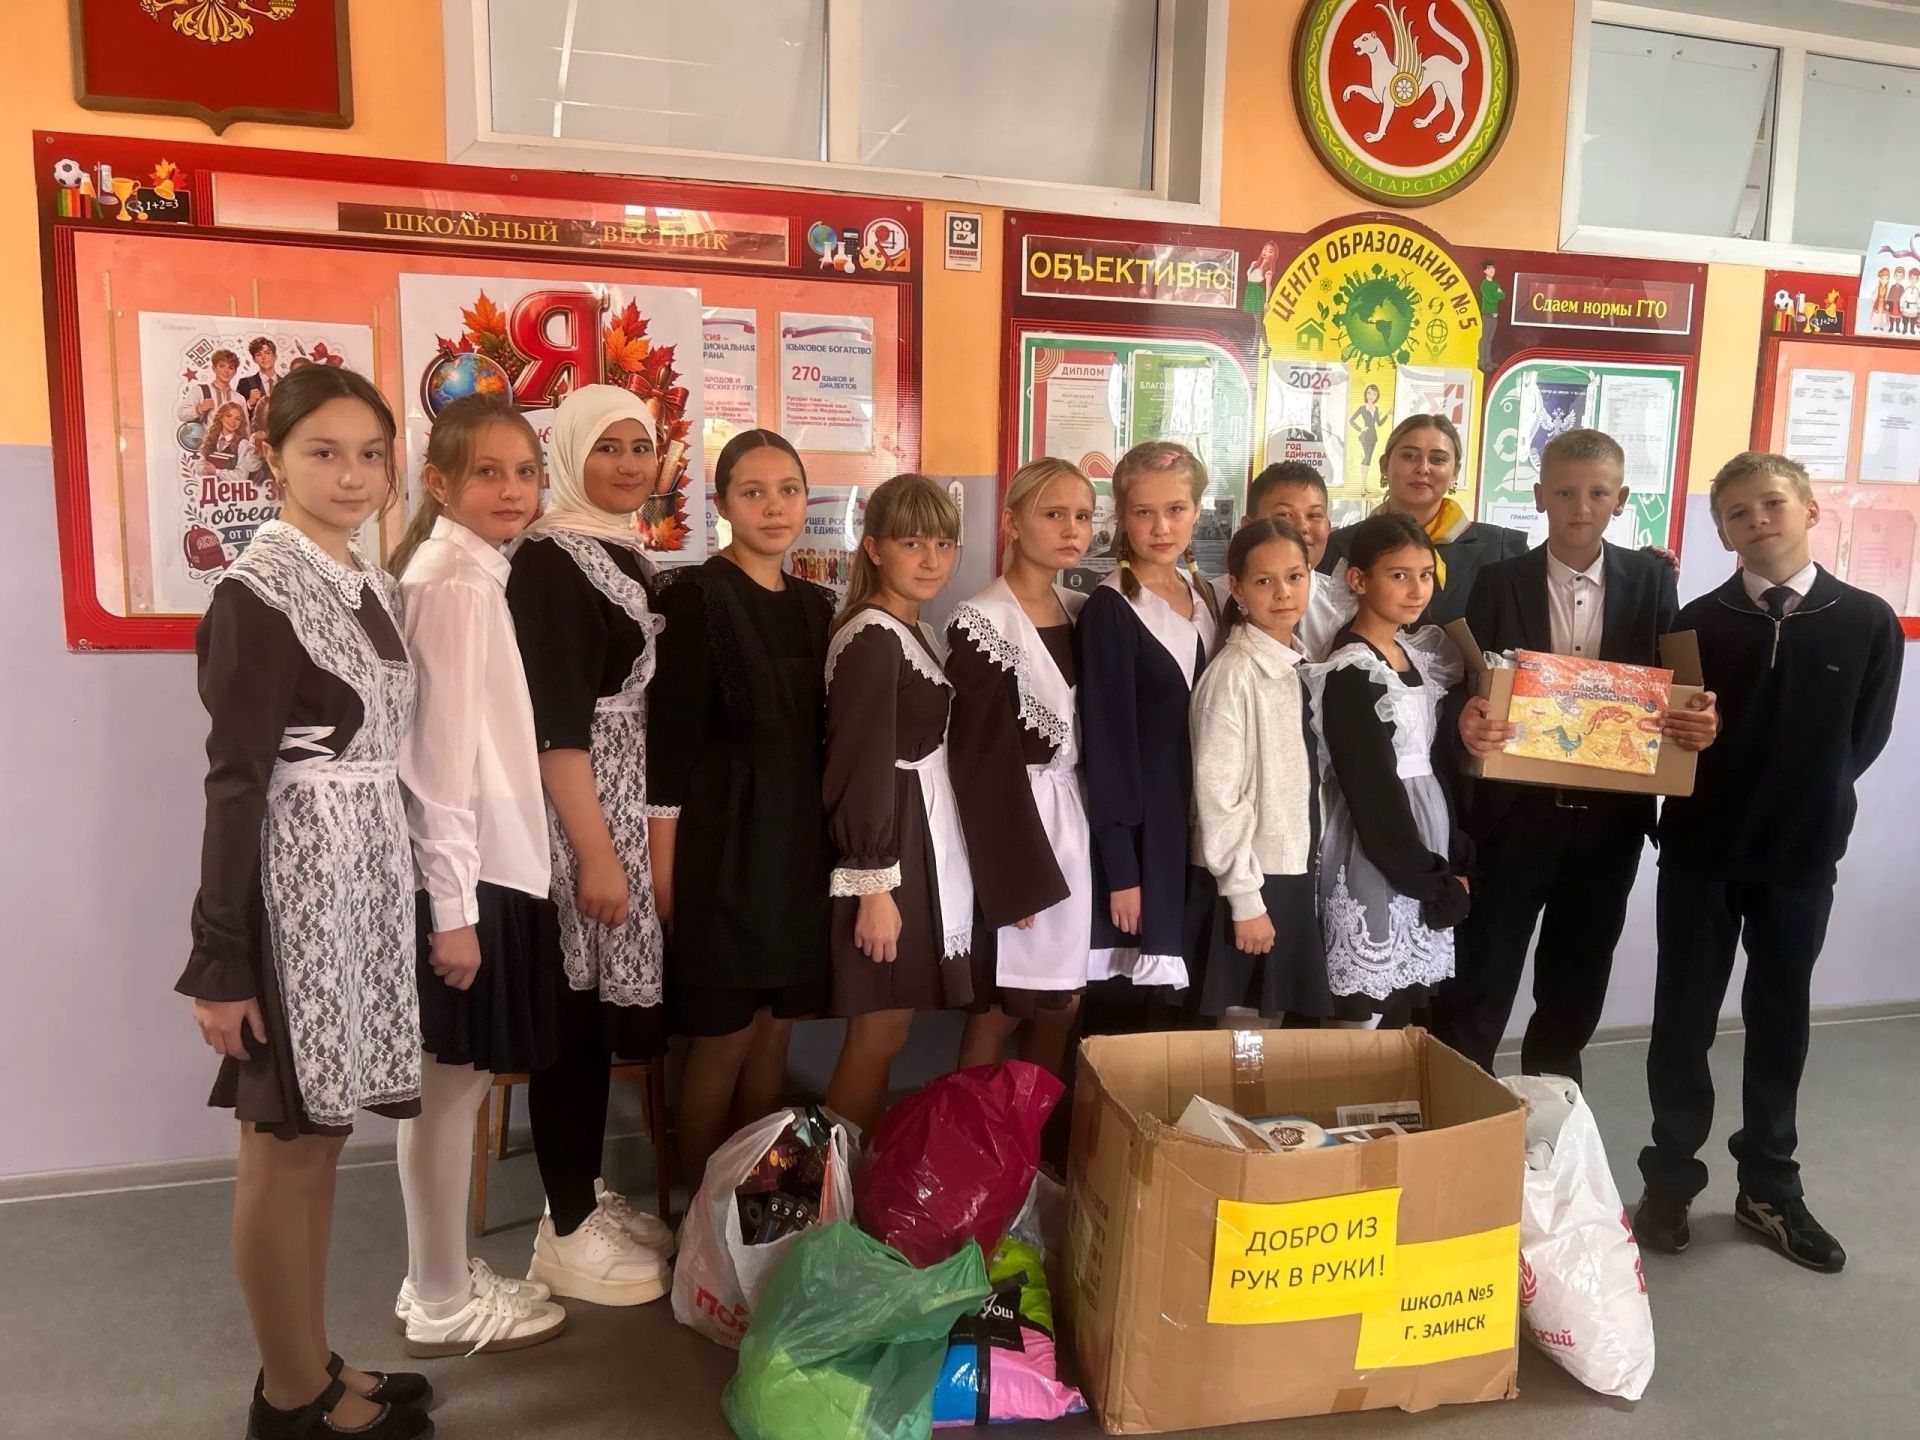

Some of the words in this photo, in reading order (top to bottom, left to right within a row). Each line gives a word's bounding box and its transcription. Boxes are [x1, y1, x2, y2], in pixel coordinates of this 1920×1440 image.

[1354, 165, 1460, 192] ТАТАРСТАН
[146, 199, 179, 211] 1+2=3
[384, 212, 560, 242] ШКОЛЬНЫЙ
[603, 225, 728, 250] ВЕСТНИК
[1273, 253, 1320, 322] ЦЕНТР
[1326, 231, 1460, 292] ОБРАЗОВАНИЯ
[1532, 293, 1579, 313] Сдаем
[1583, 301, 1632, 318] нормы
[1636, 300, 1667, 318] ГТО
[510, 290, 610, 408] Я
[703, 342, 755, 351] ИОНАЛЬНАЯ
[786, 344, 826, 352] ЯЗЫКОВОЕ
[829, 345, 871, 354] БОГАТСТВО
[704, 376, 733, 384] АРОДОВ
[792, 366, 820, 381] 270
[1061, 366, 1105, 377] ДИПЛОМ
[819, 382, 856, 390] ДИАЛЕКТОВ
[1140, 381, 1171, 391] БЛАГОД
[1289, 371, 1332, 390] 2026
[1285, 451, 1327, 459] ЕДИНСТВА
[1286, 443, 1301, 451] ГОД
[200, 478, 258, 508] День
[805, 516, 826, 525] УЩЕЕ
[1245, 1223, 1338, 1256] ДОБРО
[1347, 1216, 1378, 1240] ИЗ
[1231, 1269, 1280, 1290] РУК
[1289, 1267, 1303, 1287] В
[1312, 1255, 1385, 1285] РУКИ!
[1401, 1290, 1463, 1312] ШКОЛА
[1468, 1284, 1494, 1302] №5
[1405, 1326, 1417, 1340] Г.
[1422, 1314, 1486, 1339] ЗАИНСК
